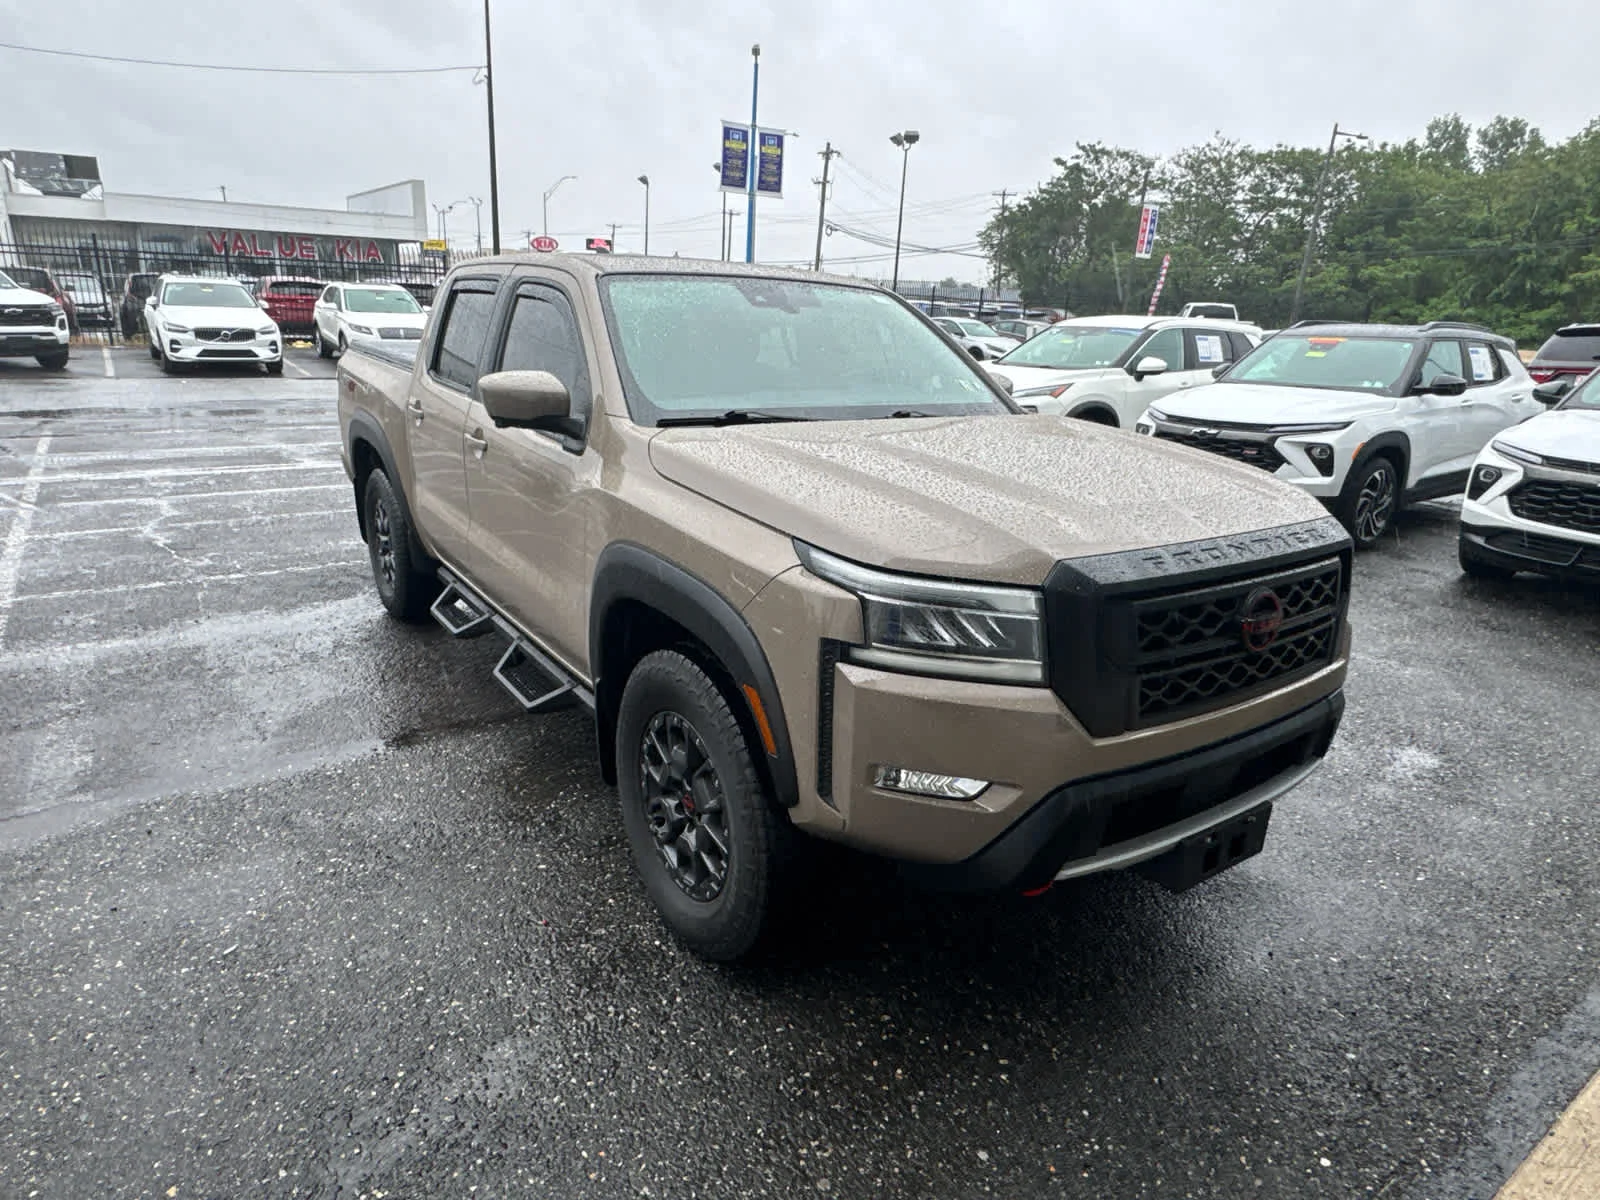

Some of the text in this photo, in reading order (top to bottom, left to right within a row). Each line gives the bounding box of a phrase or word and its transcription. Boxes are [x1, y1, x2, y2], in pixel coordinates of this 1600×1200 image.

[207, 230, 384, 264] VALUE KIA
[1141, 527, 1327, 570] FRONTIER
